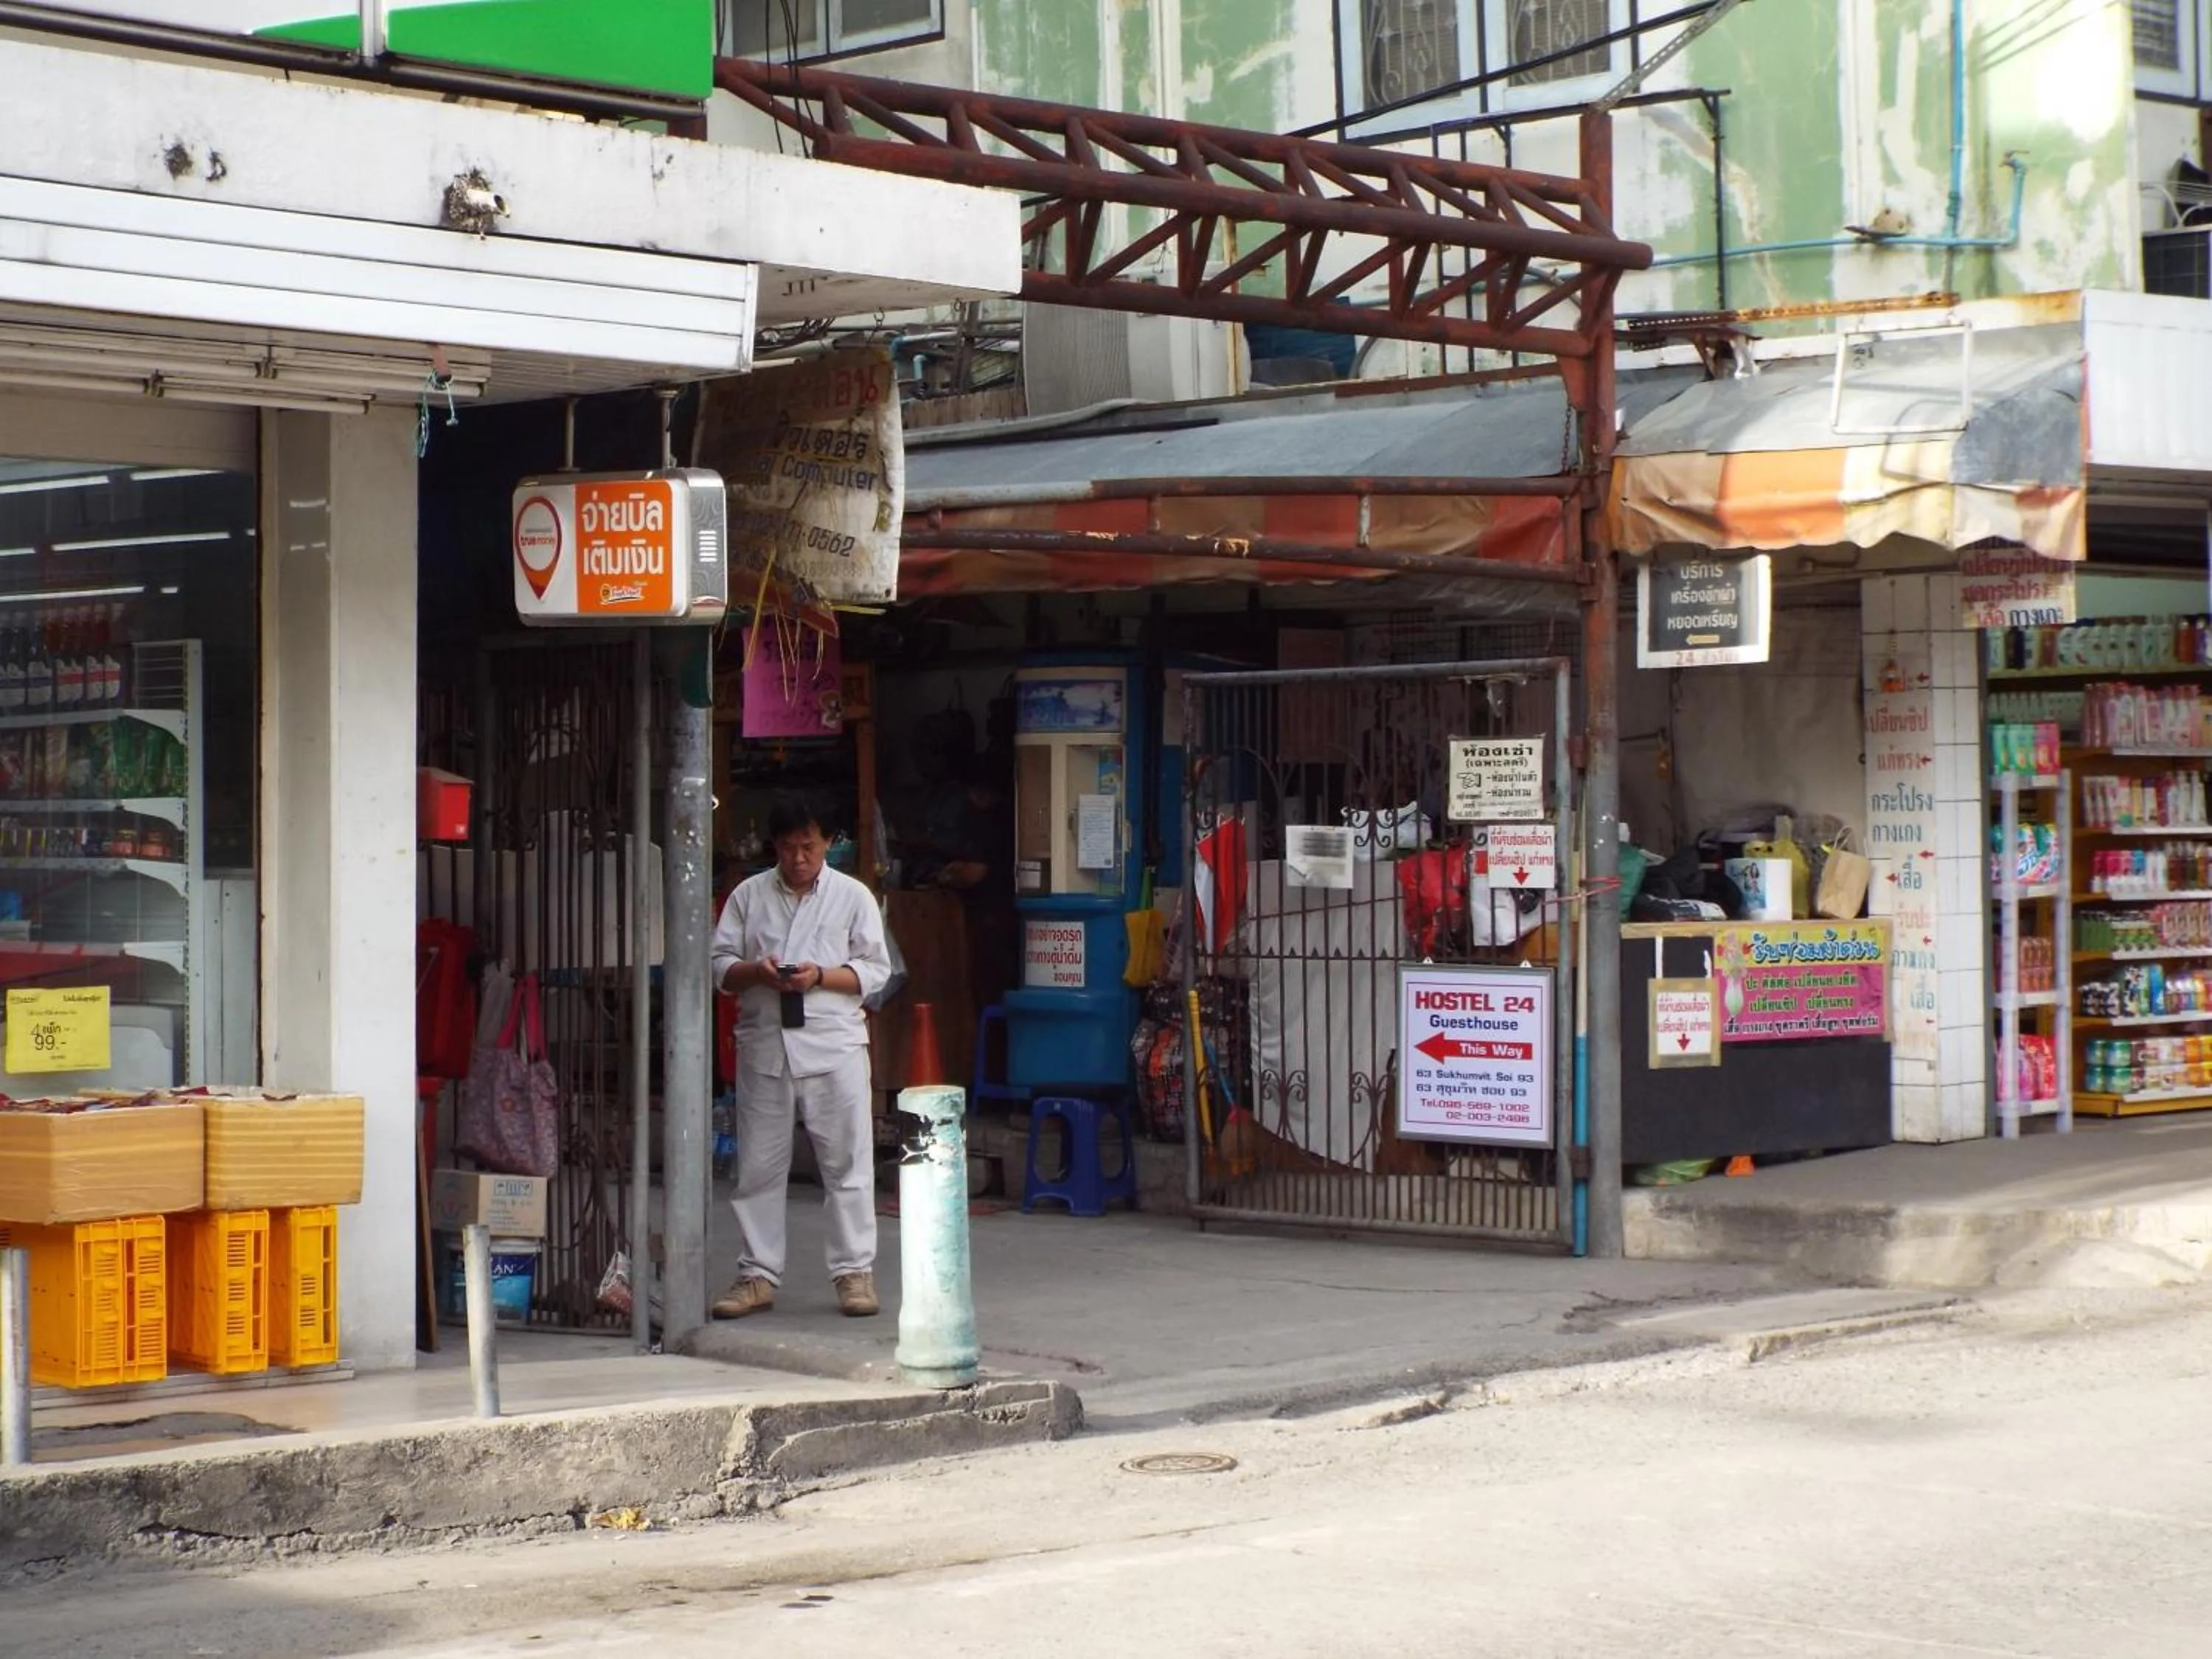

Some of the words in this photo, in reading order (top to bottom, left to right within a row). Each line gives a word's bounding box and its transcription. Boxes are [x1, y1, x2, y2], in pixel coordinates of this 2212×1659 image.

[582, 491, 663, 532] จ่ายบิล
[583, 539, 663, 575] เติมเงิน
[1680, 560, 1724, 580] บริการ
[1463, 744, 1534, 757] ห้องเช่า
[1871, 782, 1934, 813] กระโปรง
[1871, 821, 1922, 844] กางเกง
[1896, 852, 1922, 891] เสื้อ
[1415, 991, 1495, 1012] HOSTEL
[1503, 997, 1535, 1014] 24
[1430, 1014, 1519, 1031] Guesthouse
[1458, 1043, 1487, 1056] This
[1492, 1046, 1523, 1060] Way
[1436, 1069, 1491, 1082] Sukhumvit
[1496, 1072, 1512, 1082] Soi
[1436, 1082, 1477, 1096] สุขุมวิท
